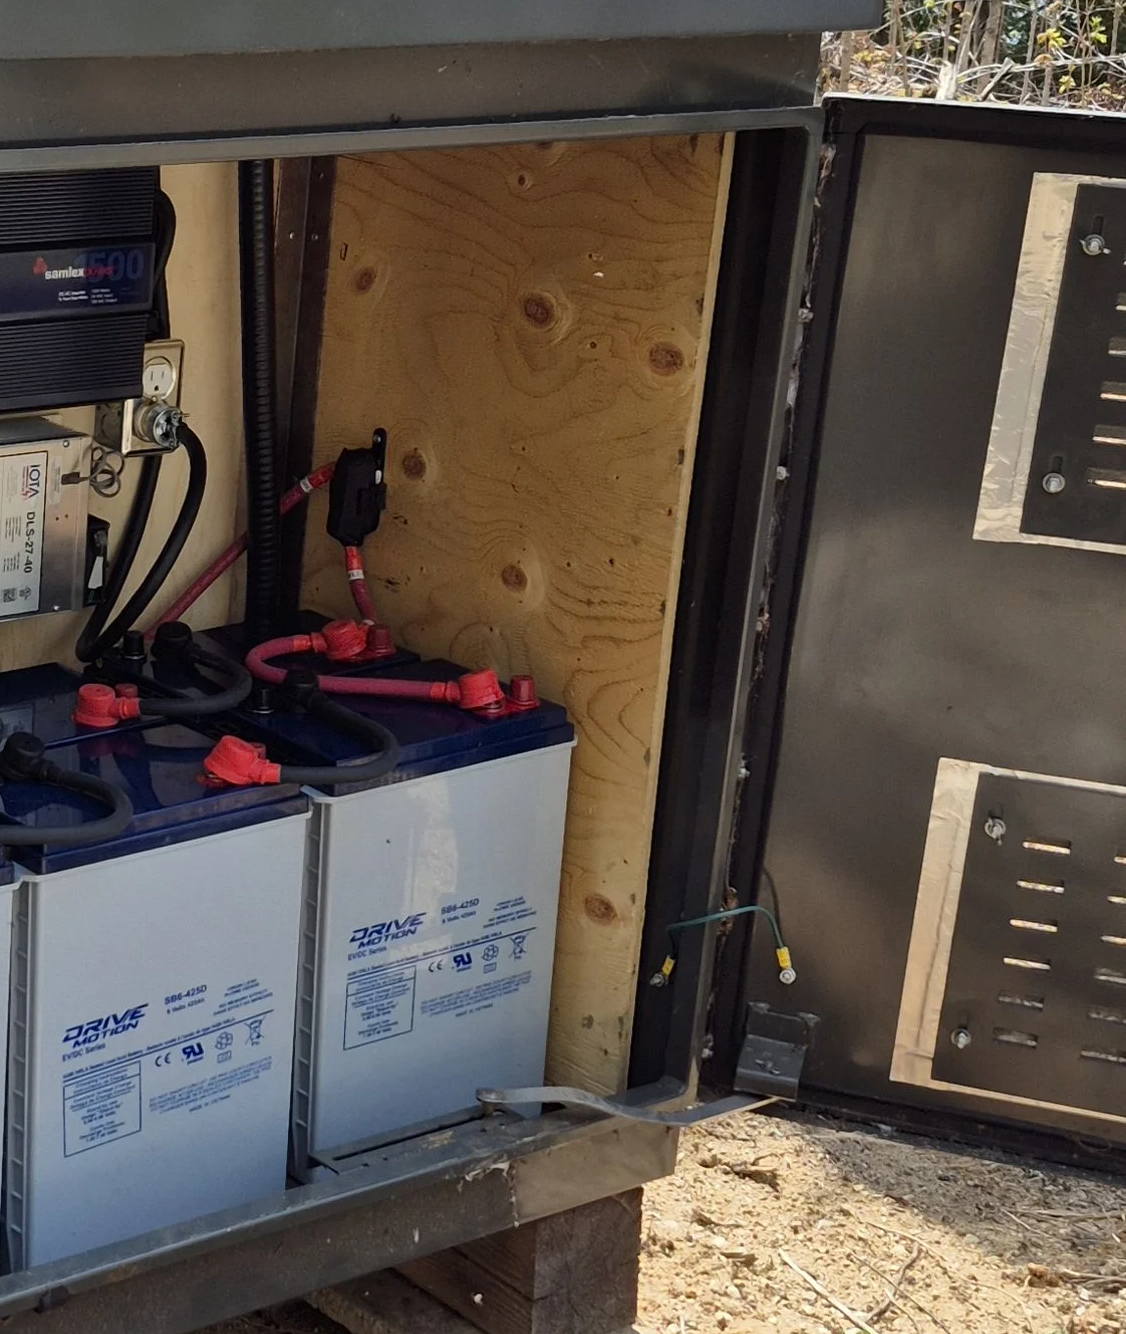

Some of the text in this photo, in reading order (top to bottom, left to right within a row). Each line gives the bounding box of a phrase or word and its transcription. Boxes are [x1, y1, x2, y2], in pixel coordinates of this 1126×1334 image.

[28, 464, 41, 498] IOTA
[23, 511, 36, 574] DLS-27-40
[349, 912, 426, 943] DRIVE
[358, 927, 417, 949] MOTION
[165, 985, 207, 1005] SB6-425D
[63, 1003, 148, 1043] DRIVE
[73, 1017, 140, 1048] MOTION
